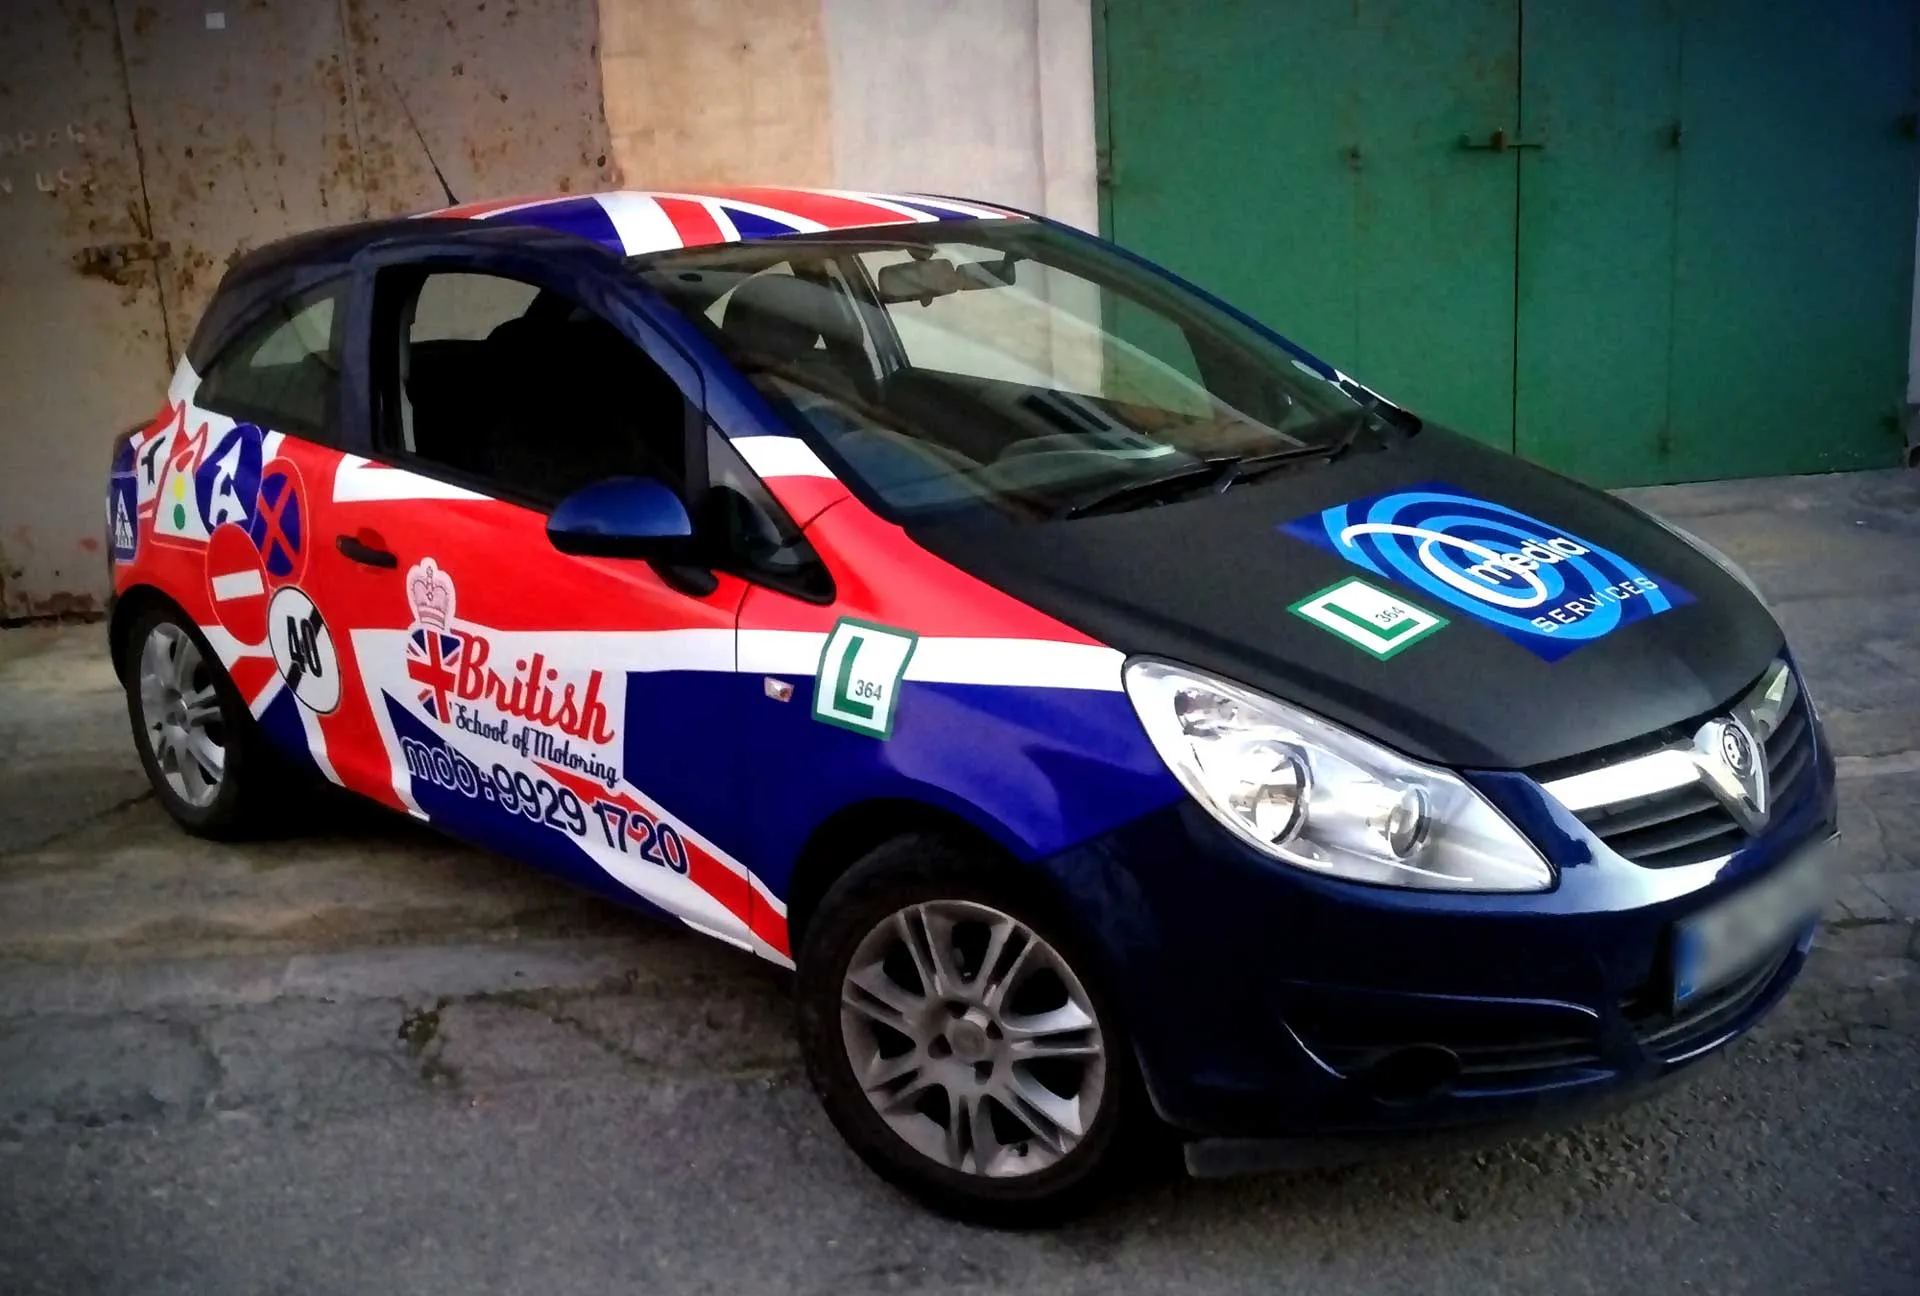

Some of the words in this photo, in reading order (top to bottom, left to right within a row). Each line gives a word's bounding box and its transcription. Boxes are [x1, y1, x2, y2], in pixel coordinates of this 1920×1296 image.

[1464, 537, 1590, 584] media
[1321, 602, 1421, 642] L
[1375, 606, 1406, 623] 364
[1531, 577, 1659, 633] SERVICES
[287, 615, 323, 678] 40
[833, 636, 875, 710] L
[452, 629, 615, 744] British
[855, 679, 883, 701] 364
[455, 703, 509, 744] School
[512, 726, 531, 757] of
[530, 728, 620, 789] Motoring
[592, 801, 689, 875] 1720
